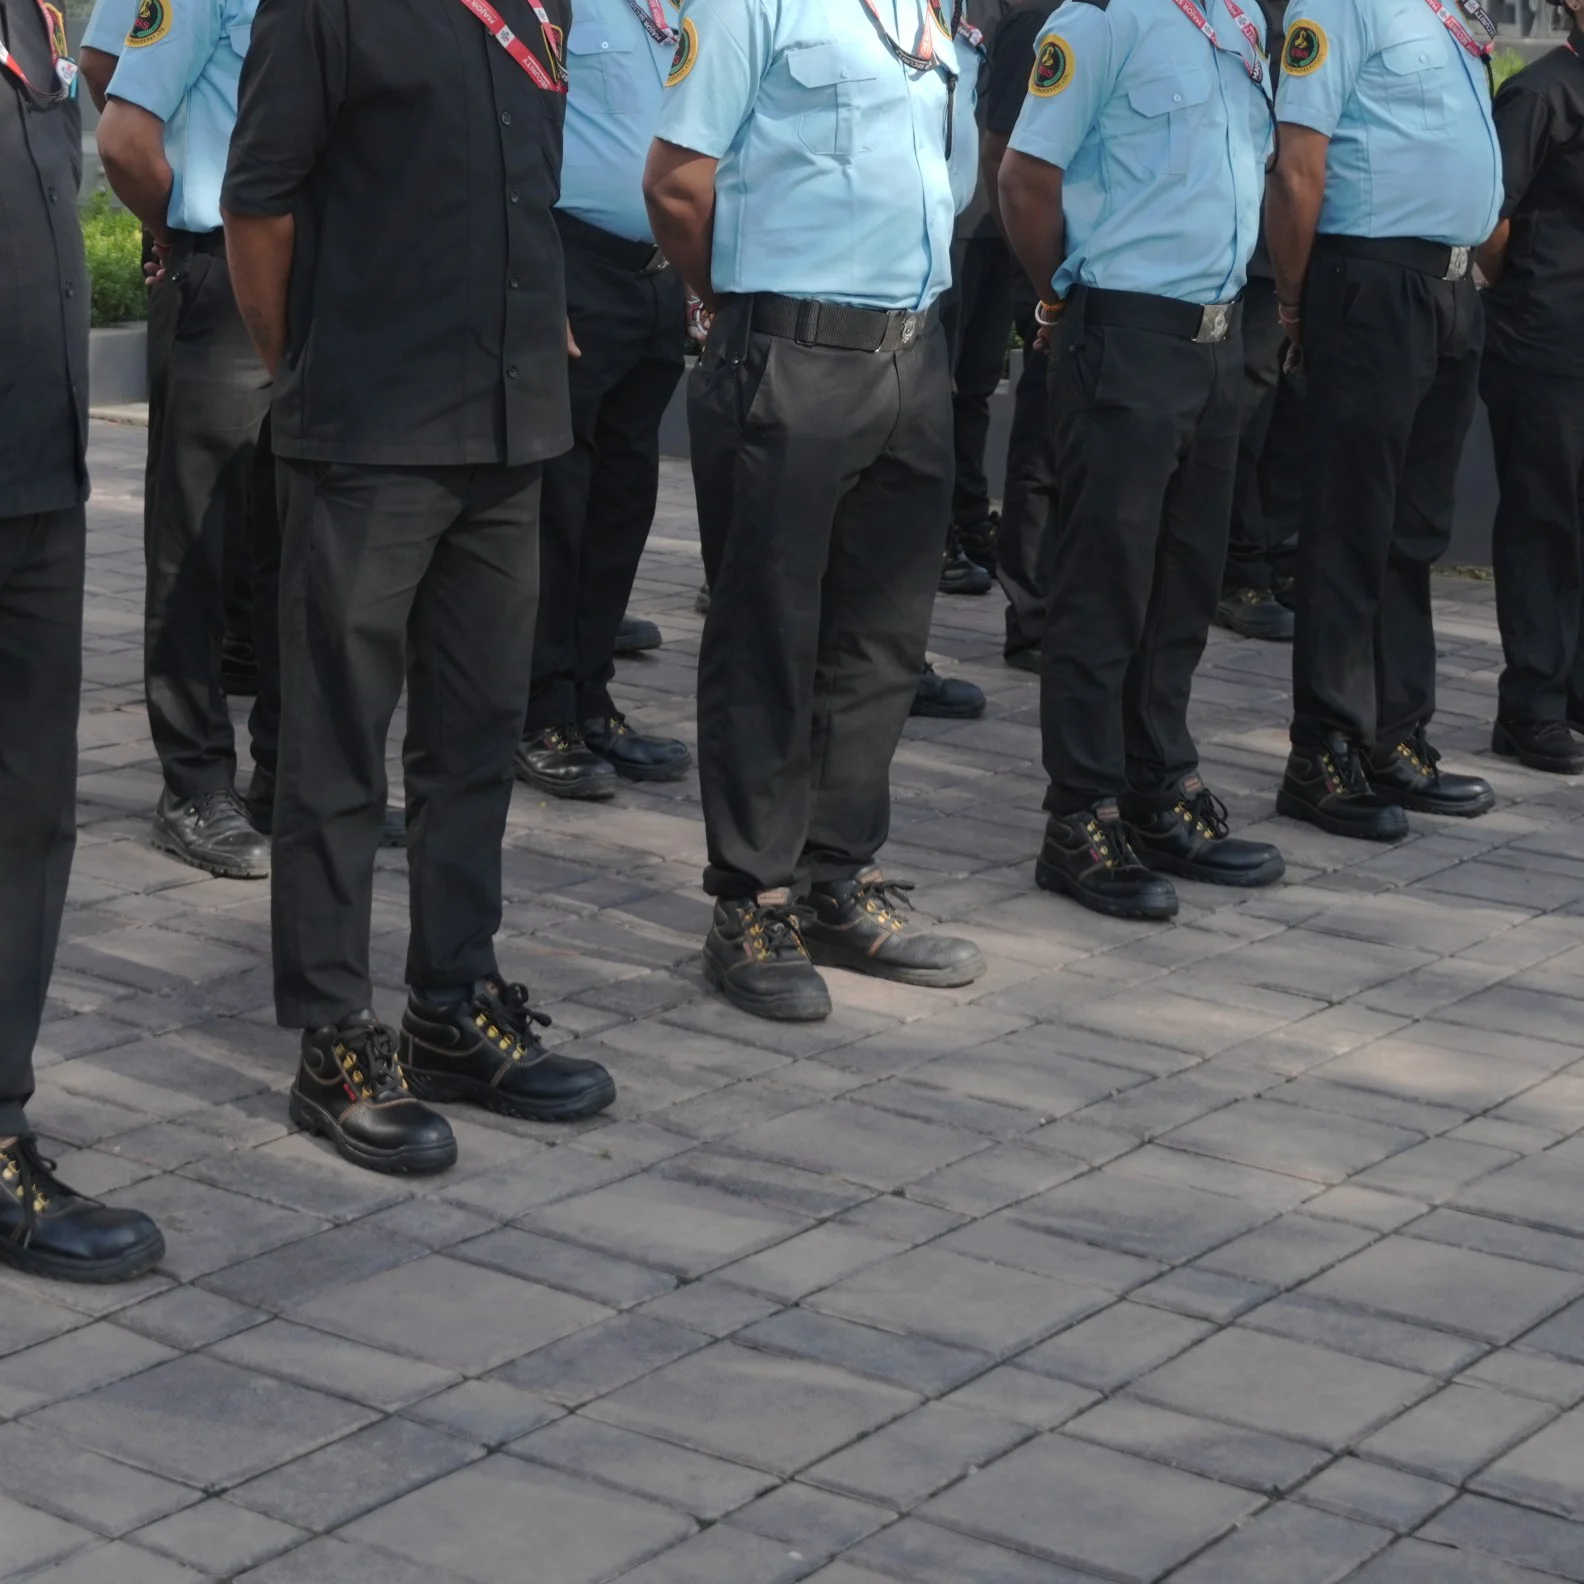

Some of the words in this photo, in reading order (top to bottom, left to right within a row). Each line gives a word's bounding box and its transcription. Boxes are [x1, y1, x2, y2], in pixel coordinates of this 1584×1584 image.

[471, 0, 496, 25] MAJOR
[1183, 4, 1202, 26] MAJOR
[1474, 10, 1495, 38] ECURITY
[643, 21, 663, 42] MAJOR
[522, 57, 549, 90] SECURITY
